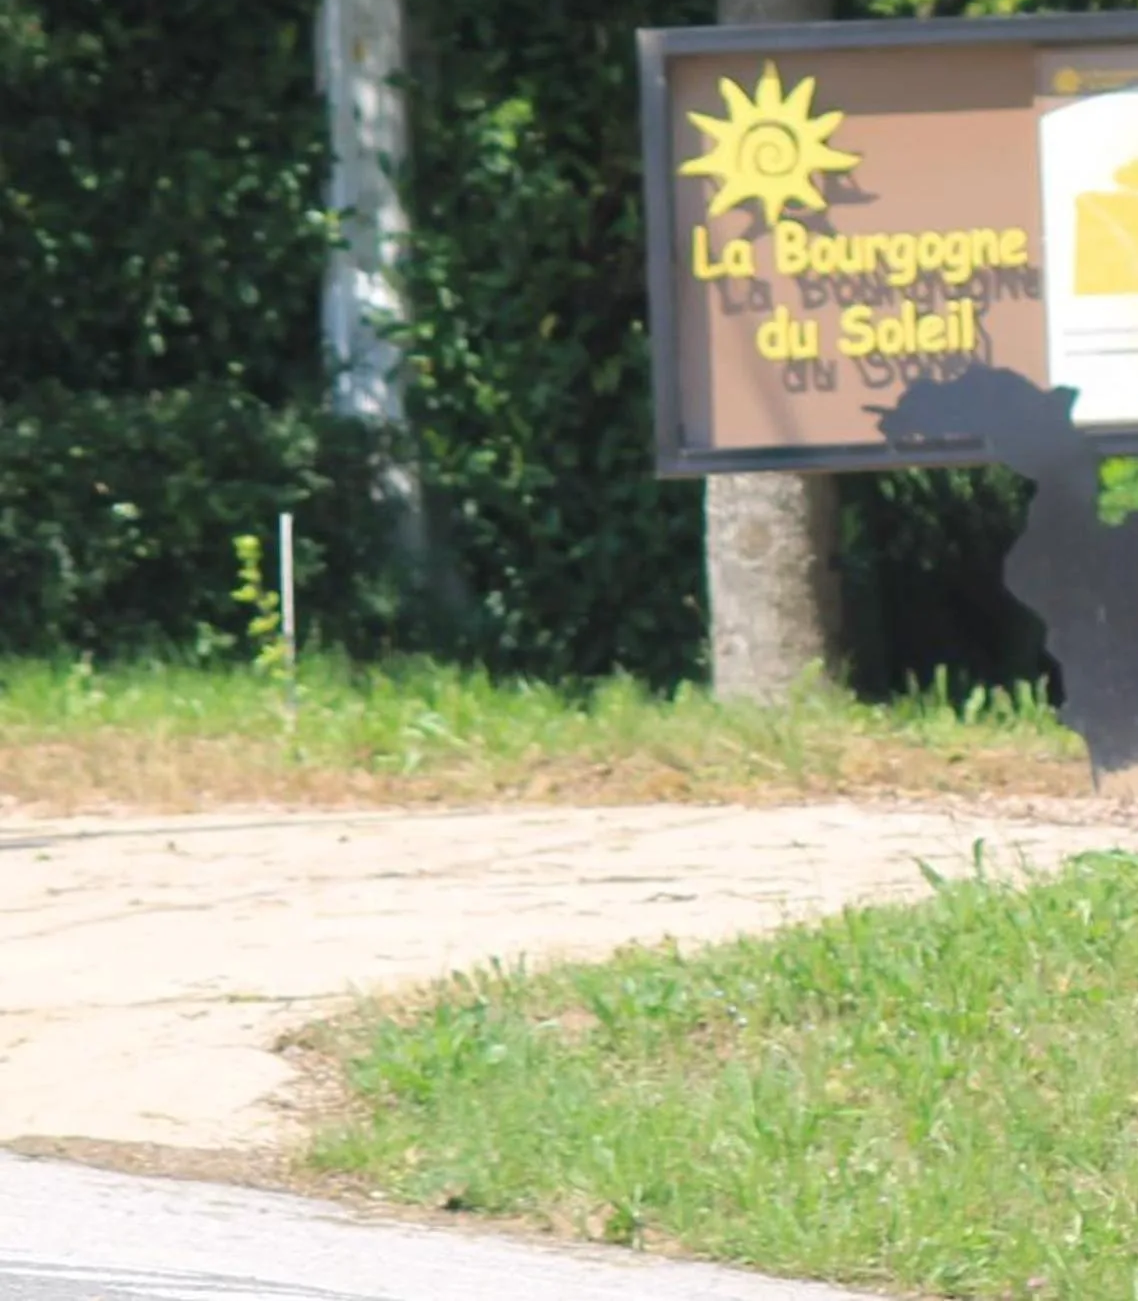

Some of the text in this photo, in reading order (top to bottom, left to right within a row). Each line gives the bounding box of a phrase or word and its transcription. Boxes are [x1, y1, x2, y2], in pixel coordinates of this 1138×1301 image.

[693, 220, 1028, 286] La Bourgogne
[757, 298, 975, 361] du Soleil
